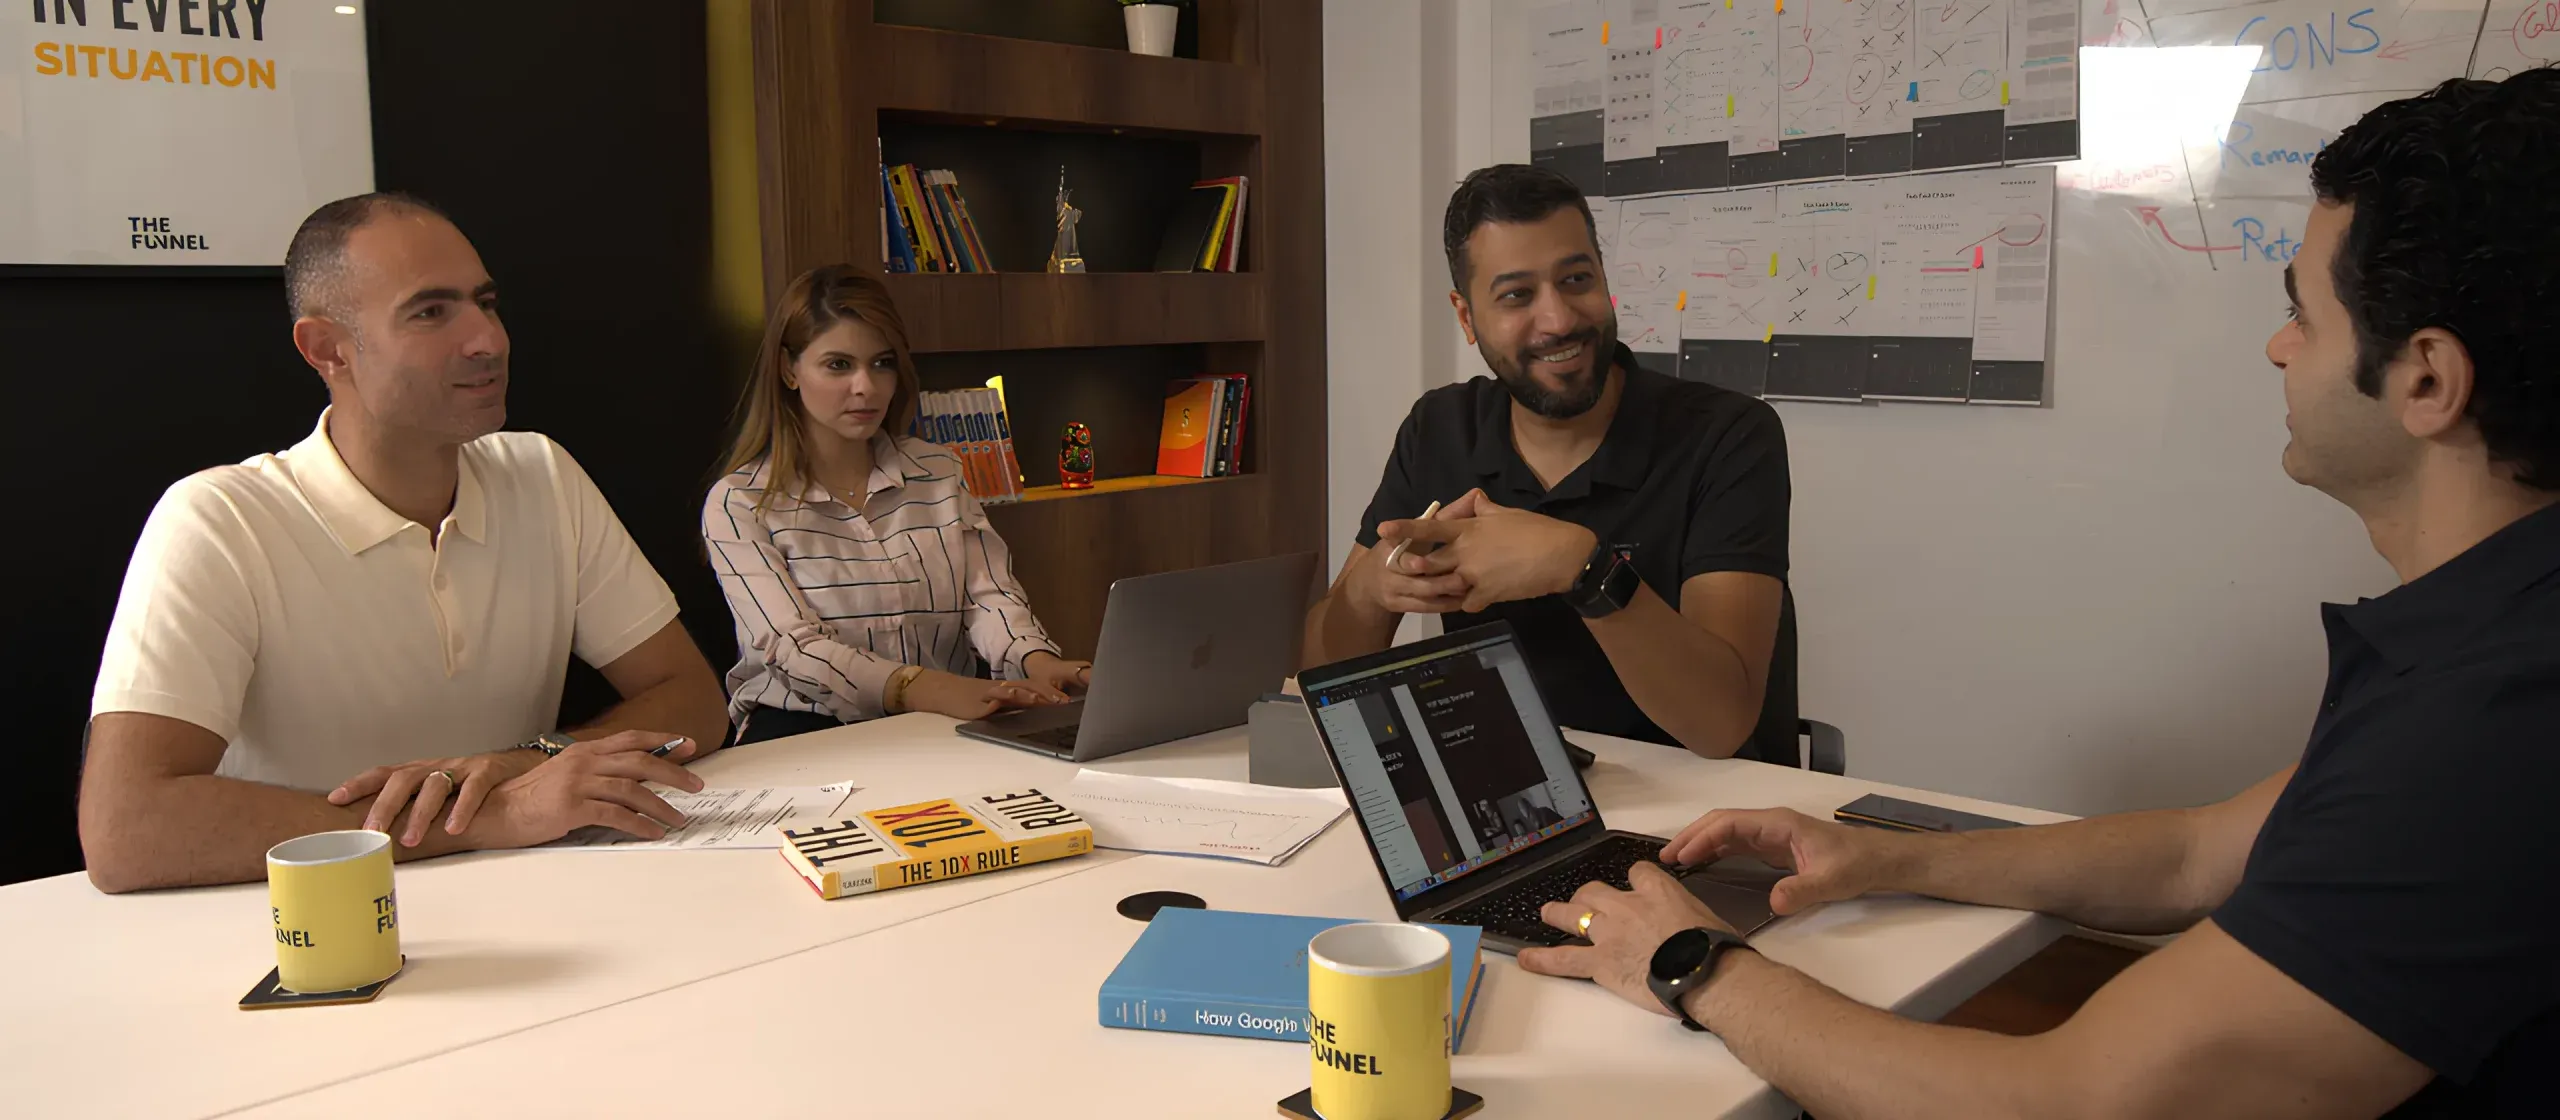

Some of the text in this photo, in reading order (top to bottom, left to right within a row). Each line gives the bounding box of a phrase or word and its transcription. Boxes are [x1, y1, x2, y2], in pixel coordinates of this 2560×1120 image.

[34, 42, 276, 90] SITUATION
[2214, 121, 2326, 170] Remar
[128, 217, 170, 232] THE
[132, 234, 209, 250] FUNNEL
[783, 788, 1083, 868] THE 10X RULE
[900, 860, 933, 884] THE
[941, 855, 971, 877] 10X
[978, 846, 1020, 871] RULE
[1195, 1009, 1232, 1027] How
